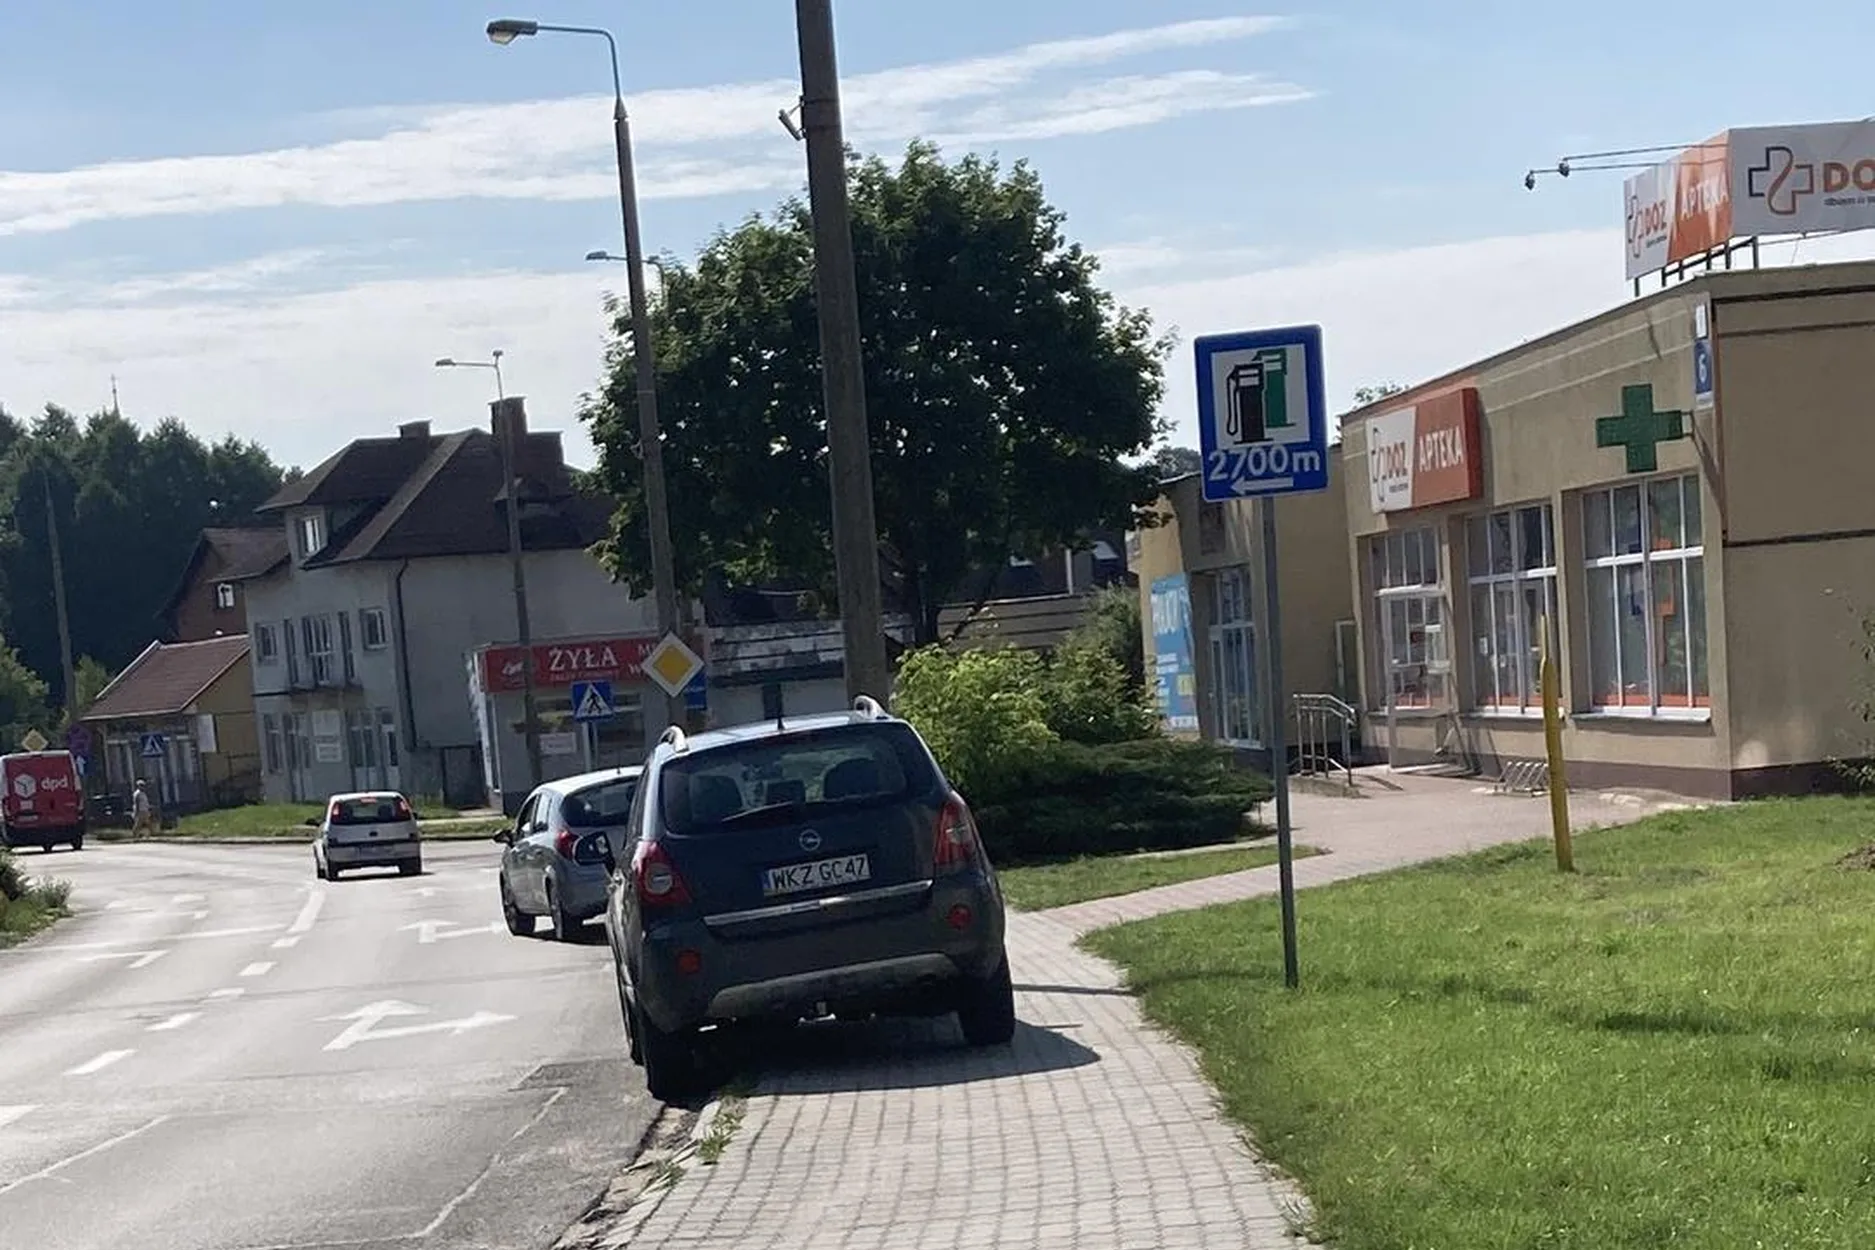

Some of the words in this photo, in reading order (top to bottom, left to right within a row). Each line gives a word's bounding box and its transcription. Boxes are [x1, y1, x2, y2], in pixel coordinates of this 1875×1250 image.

[1419, 425, 1465, 472] APTEKA
[549, 646, 619, 671] ŻYŁA
[41, 775, 68, 792] dpd
